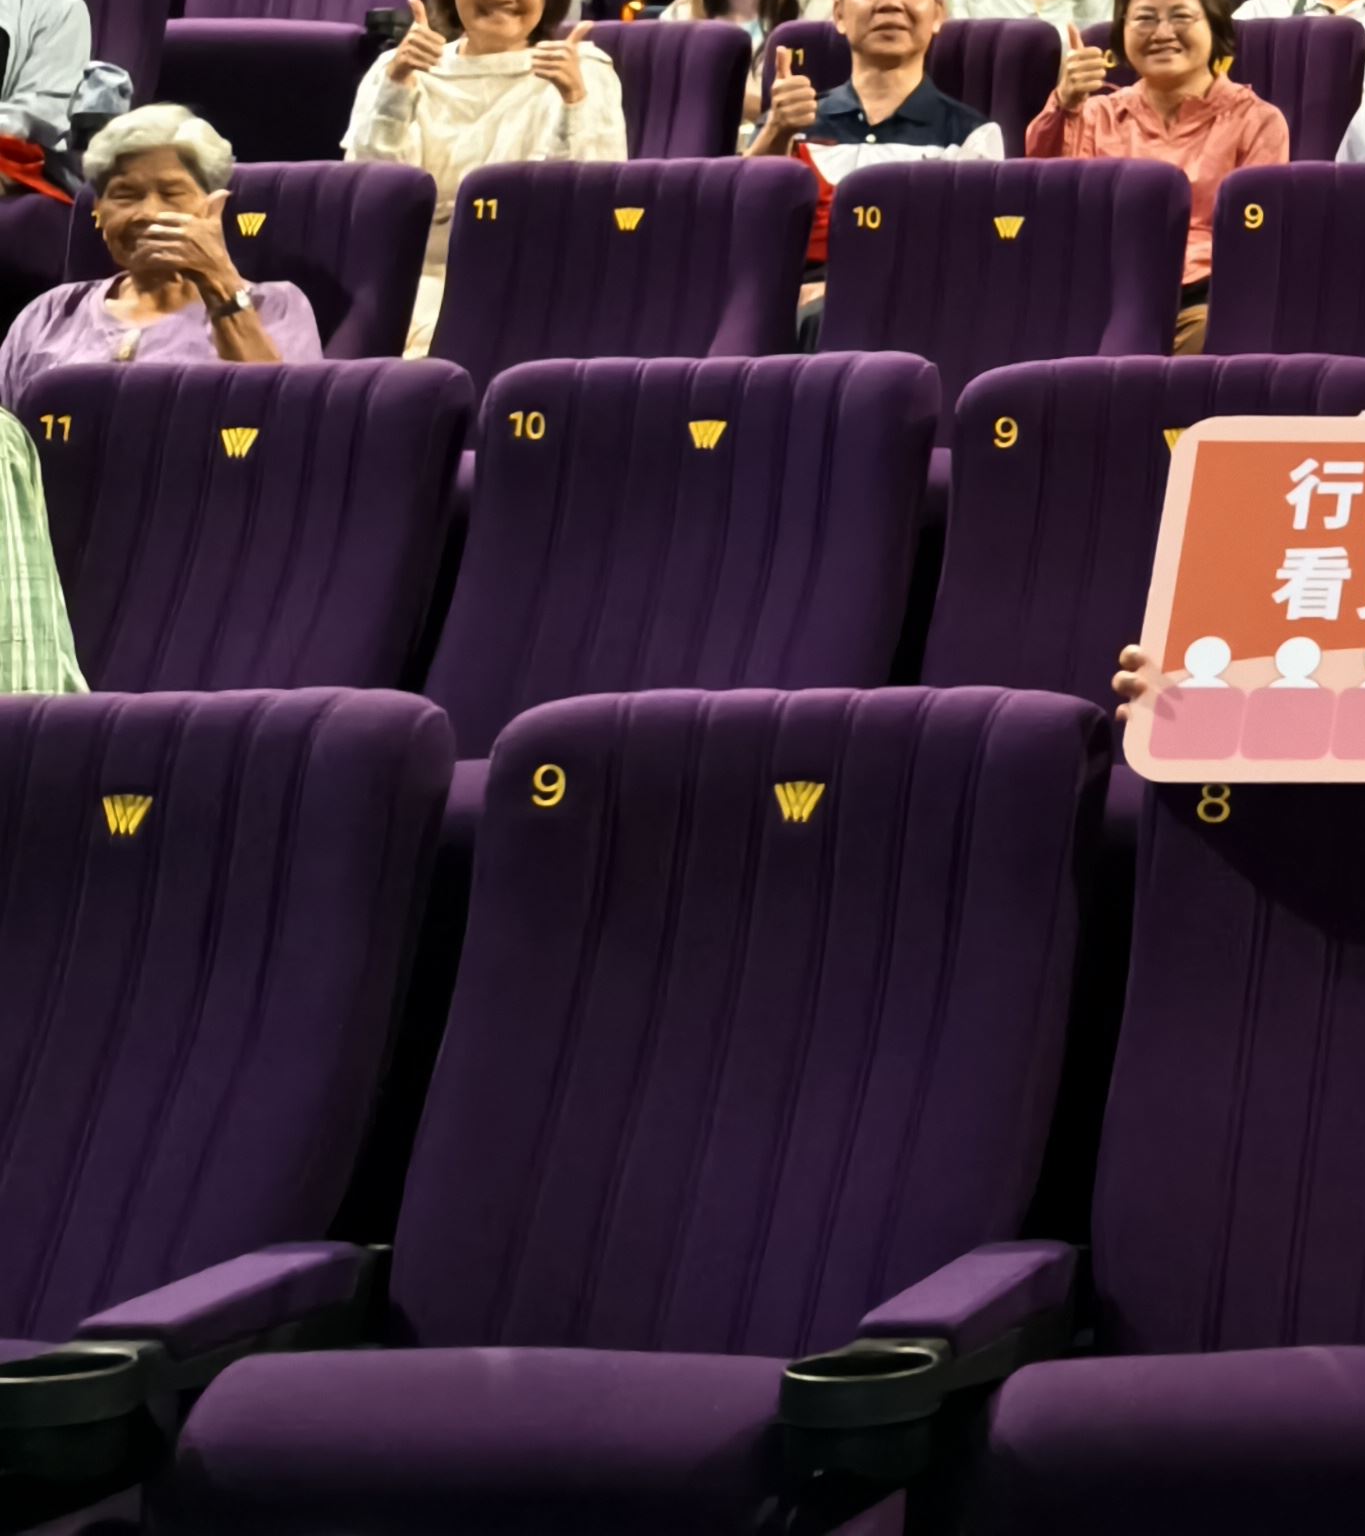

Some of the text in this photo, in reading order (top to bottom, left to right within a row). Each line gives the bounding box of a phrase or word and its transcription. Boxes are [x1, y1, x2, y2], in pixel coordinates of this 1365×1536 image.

[473, 198, 497, 220] 11
[853, 206, 881, 229] 10
[1244, 203, 1264, 229] 9
[40, 414, 71, 441] 11
[509, 411, 545, 440] 10
[994, 417, 1018, 448] 9
[532, 764, 566, 807] 9
[1196, 784, 1231, 823] 8
